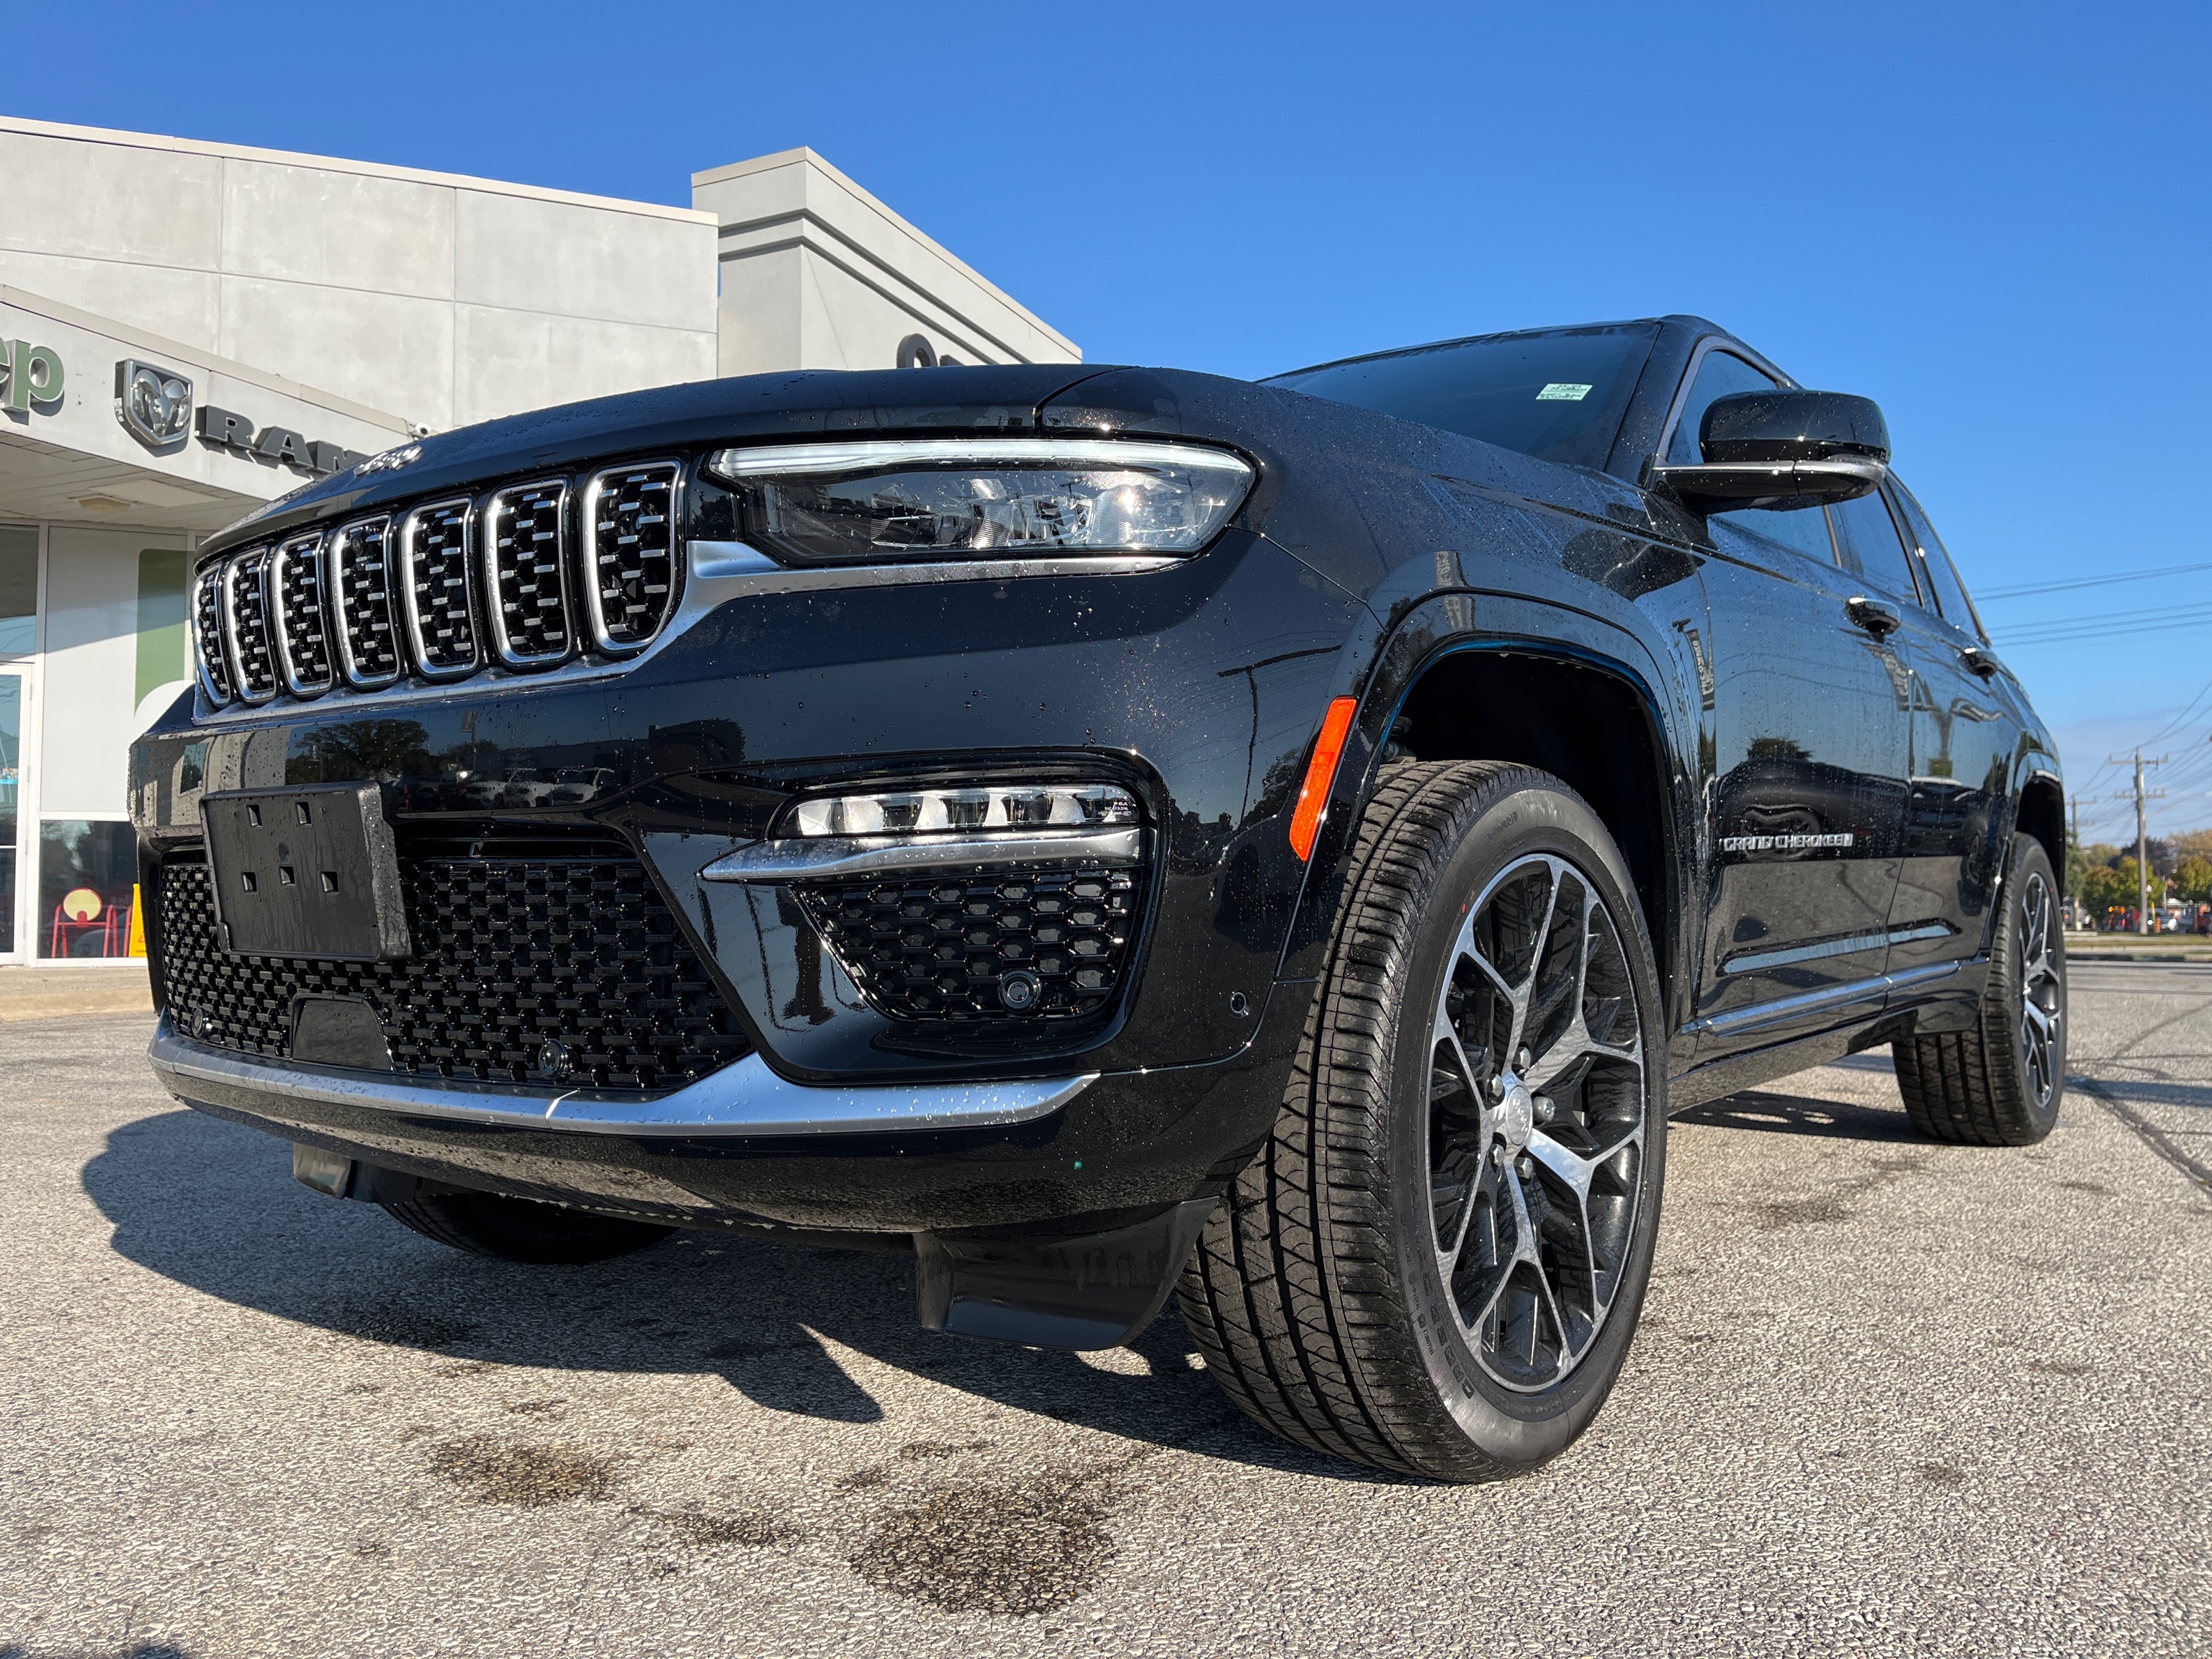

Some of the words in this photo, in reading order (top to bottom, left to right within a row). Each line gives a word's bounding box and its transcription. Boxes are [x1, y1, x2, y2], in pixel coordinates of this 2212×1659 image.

[0, 336, 65, 412] p
[1724, 835, 1773, 851] GRAND
[1775, 833, 1843, 849] CHEROKEE
